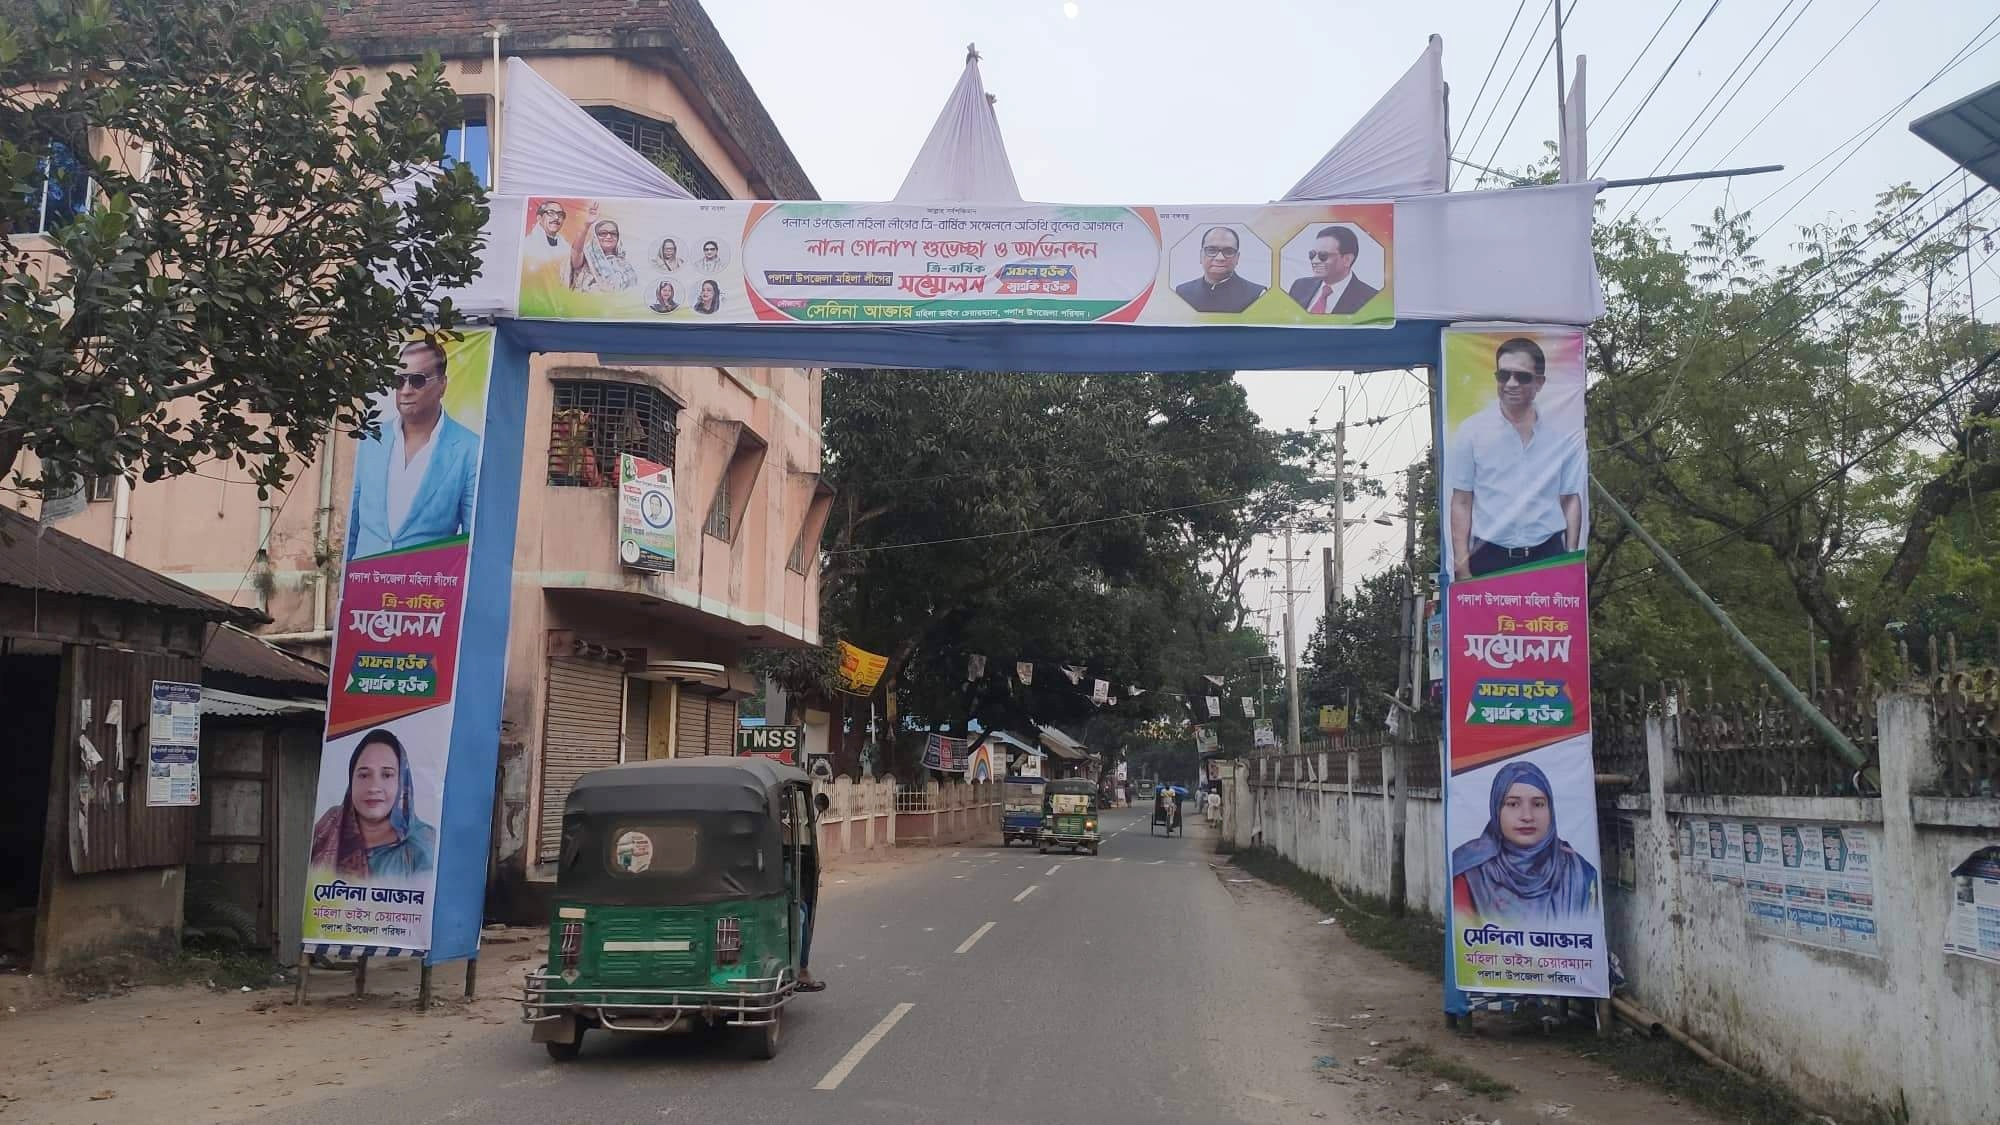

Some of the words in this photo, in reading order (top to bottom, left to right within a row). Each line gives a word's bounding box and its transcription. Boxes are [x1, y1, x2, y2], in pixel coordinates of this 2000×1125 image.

[781, 218, 809, 228] পলাশ
[813, 217, 854, 228] উপজেলা
[857, 217, 884, 229] মহিলা
[888, 218, 918, 229] লীগের
[921, 218, 966, 230] ত্রি-বার্ষিক
[970, 220, 1011, 231] সম্মেলনে
[1014, 219, 1047, 231] অতিথি
[1050, 220, 1080, 233] বৃন্দের
[1083, 221, 1123, 231] আগমনে
[804, 238, 845, 256] লাল
[851, 238, 916, 257] গোলাপ
[922, 240, 986, 258] শুভেচ্ছা
[995, 241, 1007, 257] ও
[1011, 234, 1098, 258] অভিনন্দন
[926, 261, 986, 273] ত্রি-বার্ষিক
[1006, 266, 1037, 276] সফল
[1039, 266, 1070, 277] হউক
[768, 272, 791, 283] পলাশ
[795, 272, 832, 284] উপজেলা
[836, 272, 860, 284] মহিলা
[863, 272, 891, 285] লীগের
[897, 274, 986, 298] সম্মেলন
[1042, 281, 1070, 293] হউক
[806, 300, 858, 319] সেলিনা
[863, 305, 914, 319] আক্তার
[349, 571, 370, 584] পলাশ
[373, 569, 406, 585] উপজেলা
[409, 572, 432, 586] মহিলা
[434, 571, 458, 587] লীগের
[382, 592, 446, 609] ত্রি-বার্ষিক
[1457, 594, 1482, 606] পলাশ
[1485, 592, 1522, 606] উপজেলা
[1524, 592, 1551, 608] মহিলা
[1552, 592, 1580, 608] লীগের
[349, 609, 446, 642] সম্মেলন
[1497, 615, 1568, 632] ত্রি-বার্ষিক
[1463, 633, 1572, 669] সম্মেলন
[358, 655, 393, 669] সফল
[396, 653, 429, 671] হউক
[398, 675, 429, 693] হউক
[1478, 682, 1519, 697] সফল
[1523, 681, 1559, 699] হউক
[1527, 704, 1564, 723] হউক
[739, 730, 796, 747] TMSS
[314, 879, 367, 901] সেলিনা
[371, 887, 425, 905] আক্তার
[313, 905, 341, 919] মহিলা
[343, 907, 370, 920] ভাইস
[375, 910, 422, 923] চেয়ারম্যান
[321, 922, 342, 932] পলাশ
[346, 922, 379, 934] উপজেলা
[1464, 923, 1524, 947] সেলিনা
[1529, 931, 1592, 949] আক্তার
[1465, 951, 1497, 965] মহিলা
[1502, 953, 1532, 968] ভাইস
[1537, 957, 1592, 970] চেয়ারম্যান
[1477, 970, 1502, 980] পলাশ
[1505, 969, 1543, 982] উপজেলা
